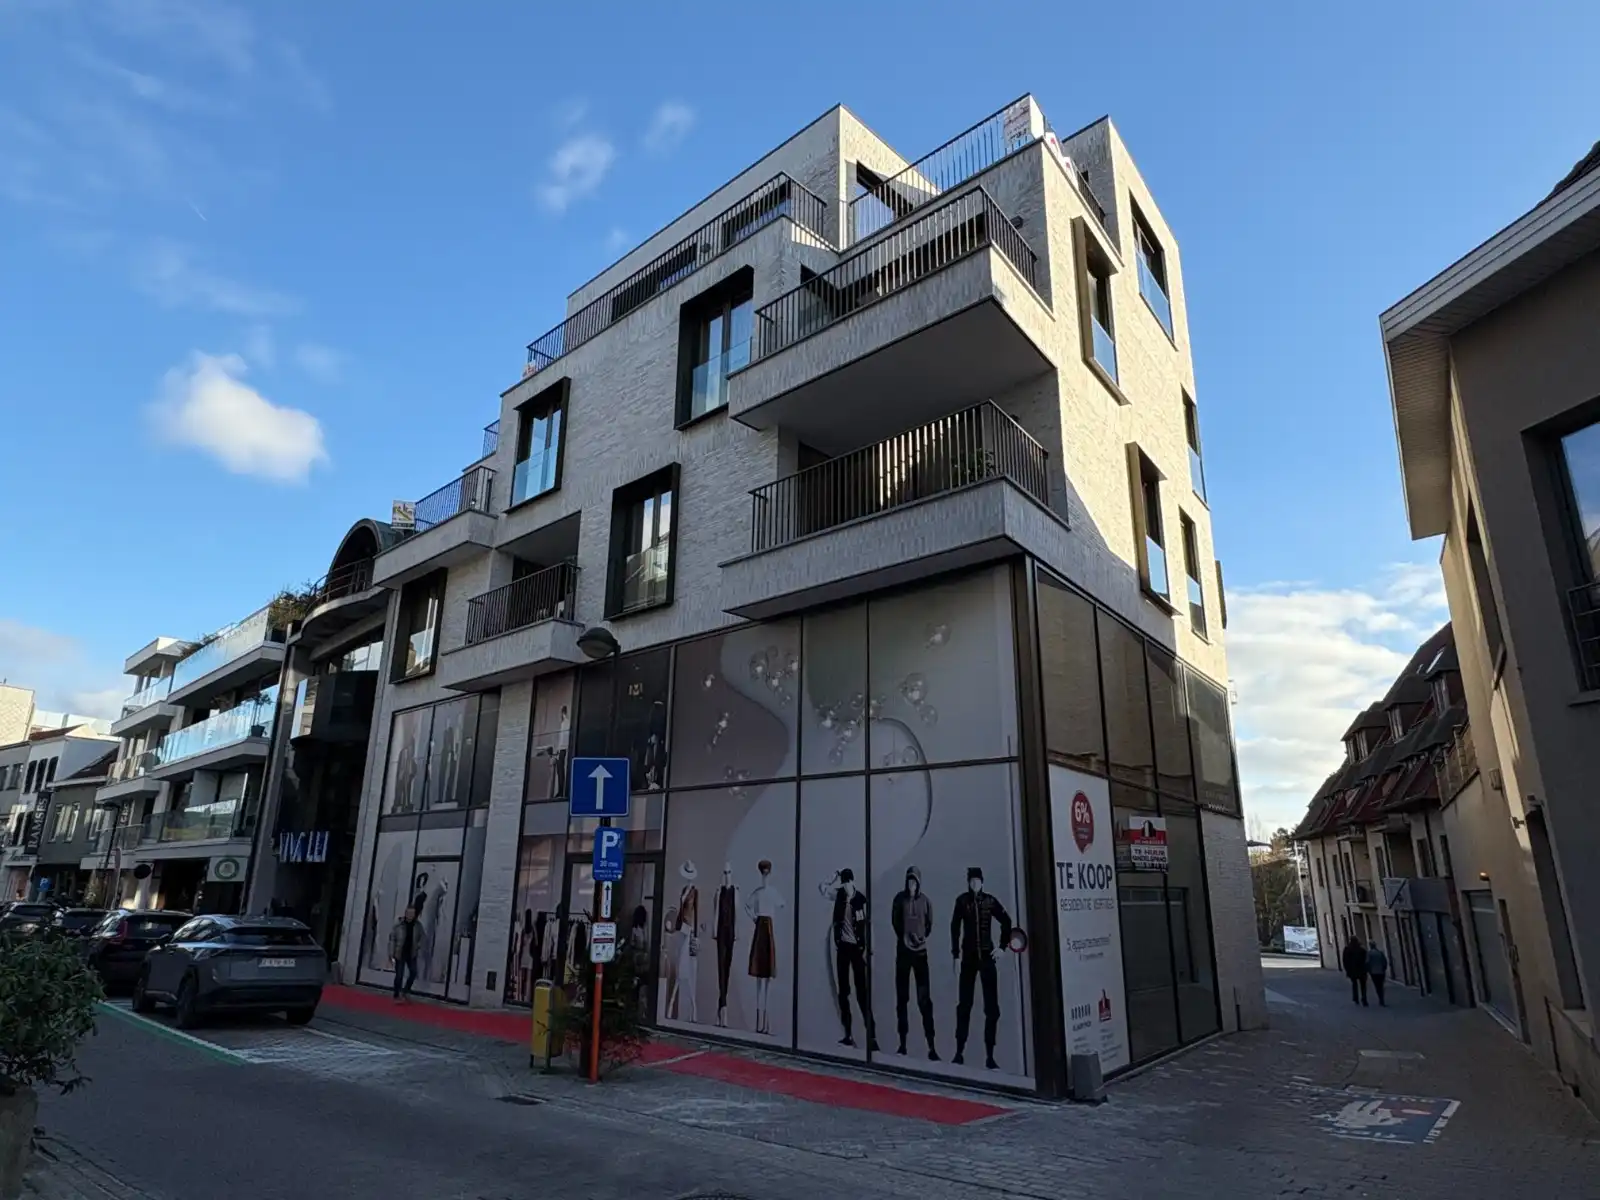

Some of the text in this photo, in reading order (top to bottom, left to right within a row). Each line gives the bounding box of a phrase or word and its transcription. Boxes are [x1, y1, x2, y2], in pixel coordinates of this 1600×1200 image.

[27, 798, 48, 848] RAMSES
[1074, 801, 1090, 824] 6%
[602, 831, 618, 858] P
[1056, 862, 1113, 890] TE KOOP
